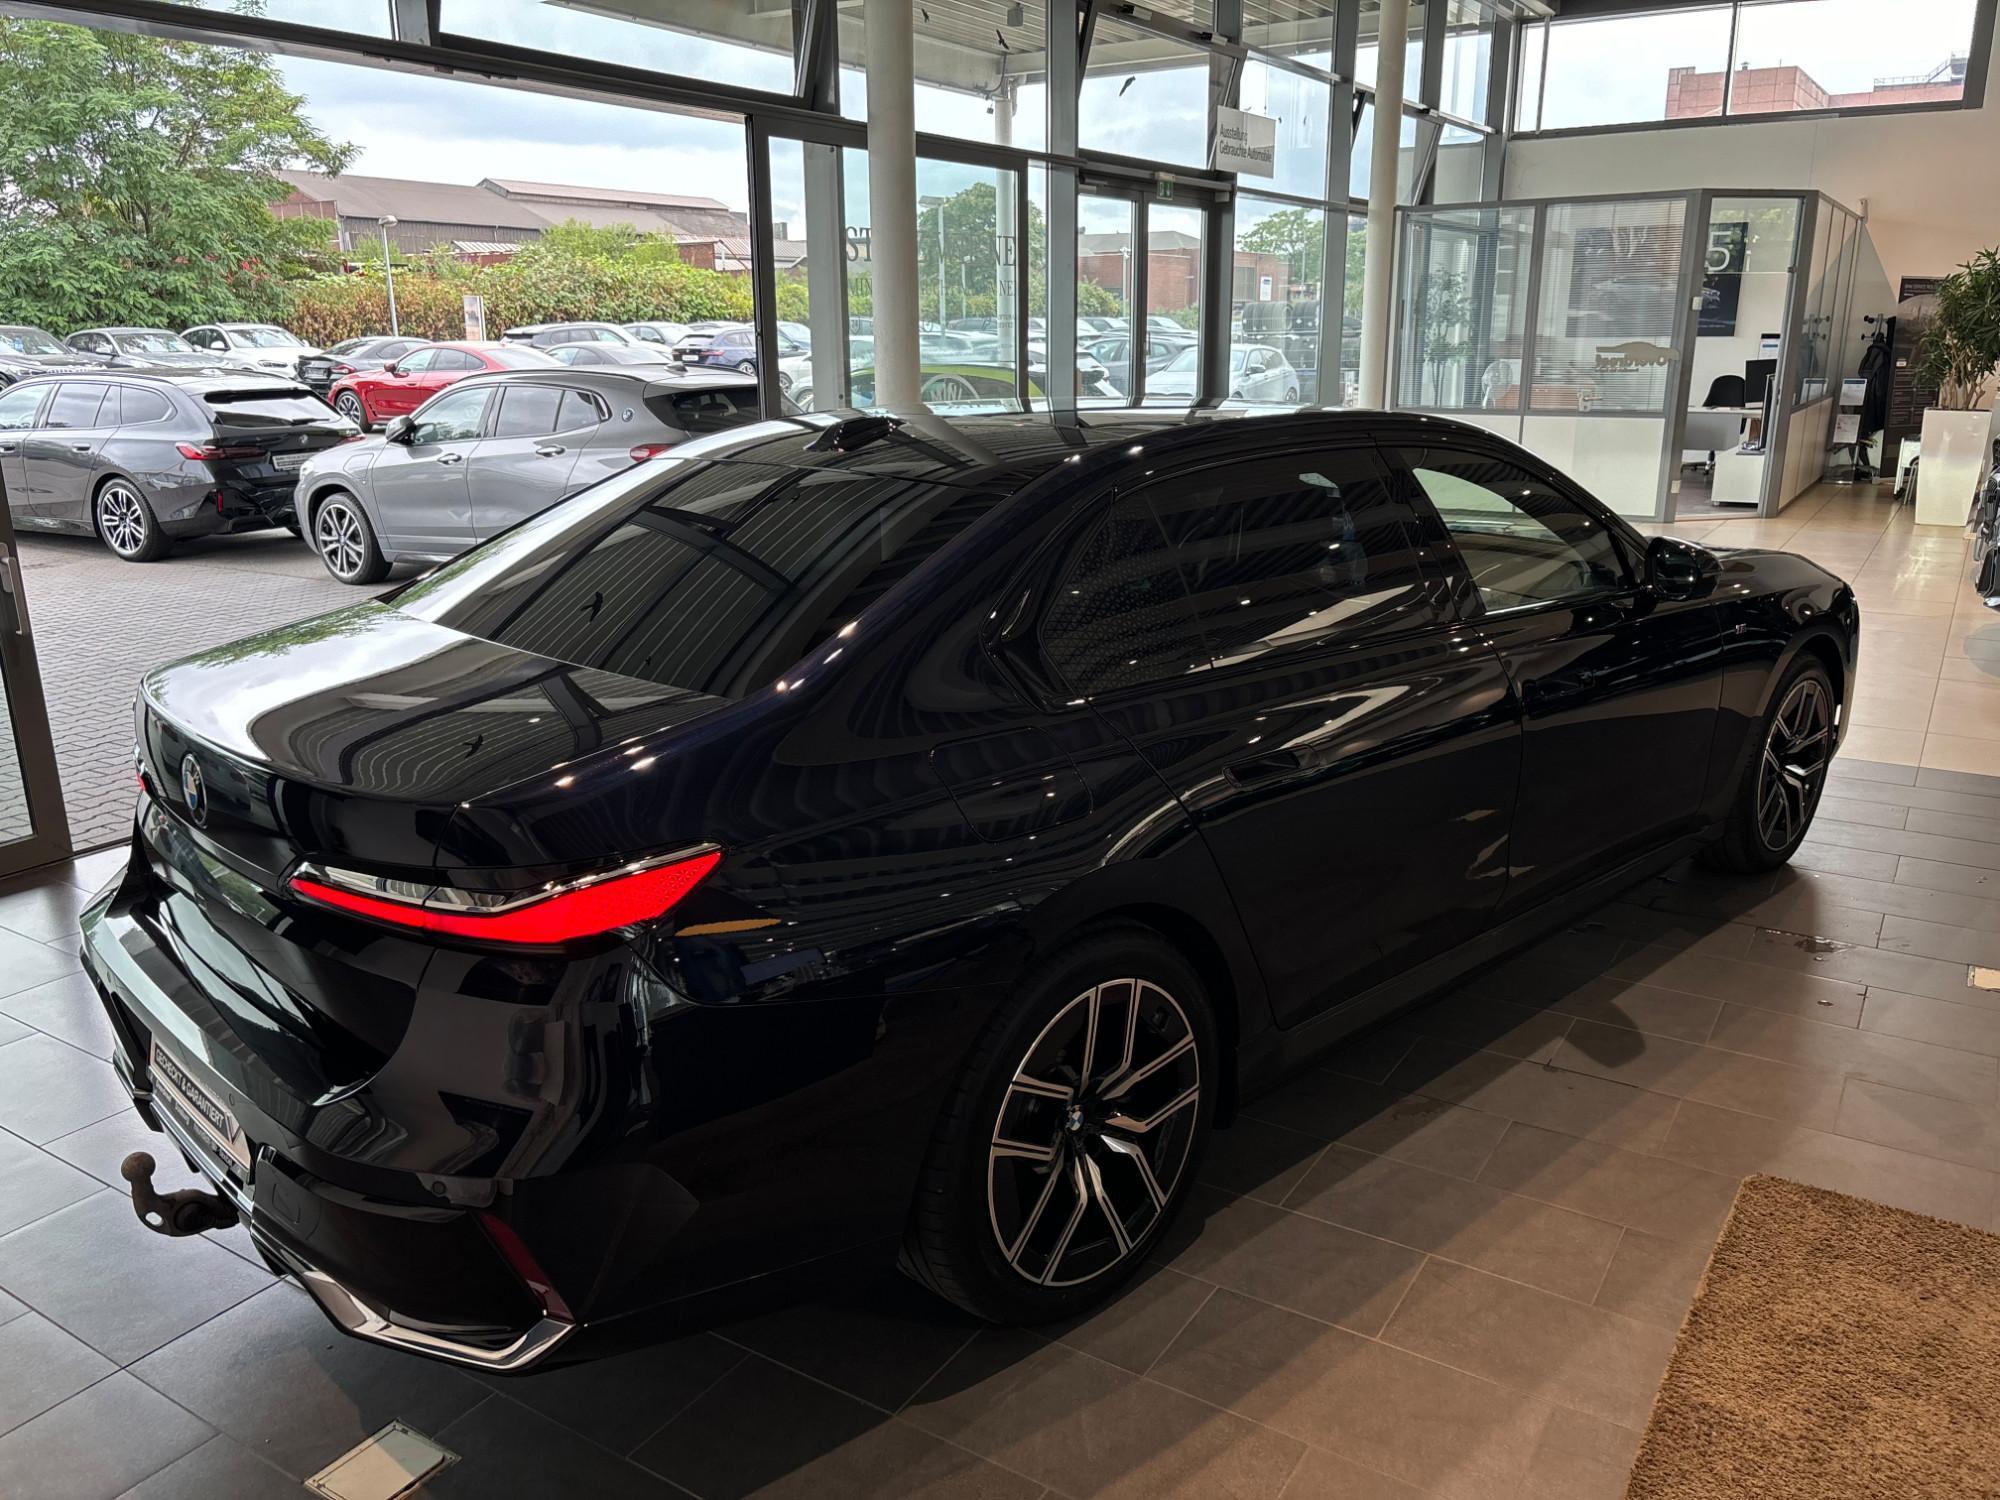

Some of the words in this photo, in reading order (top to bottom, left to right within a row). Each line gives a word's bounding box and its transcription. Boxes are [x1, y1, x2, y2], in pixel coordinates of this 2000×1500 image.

[1220, 124, 1248, 146] Ausstellung
[1220, 140, 1247, 158] Gebrauchte
[1247, 146, 1272, 163] Automobile
